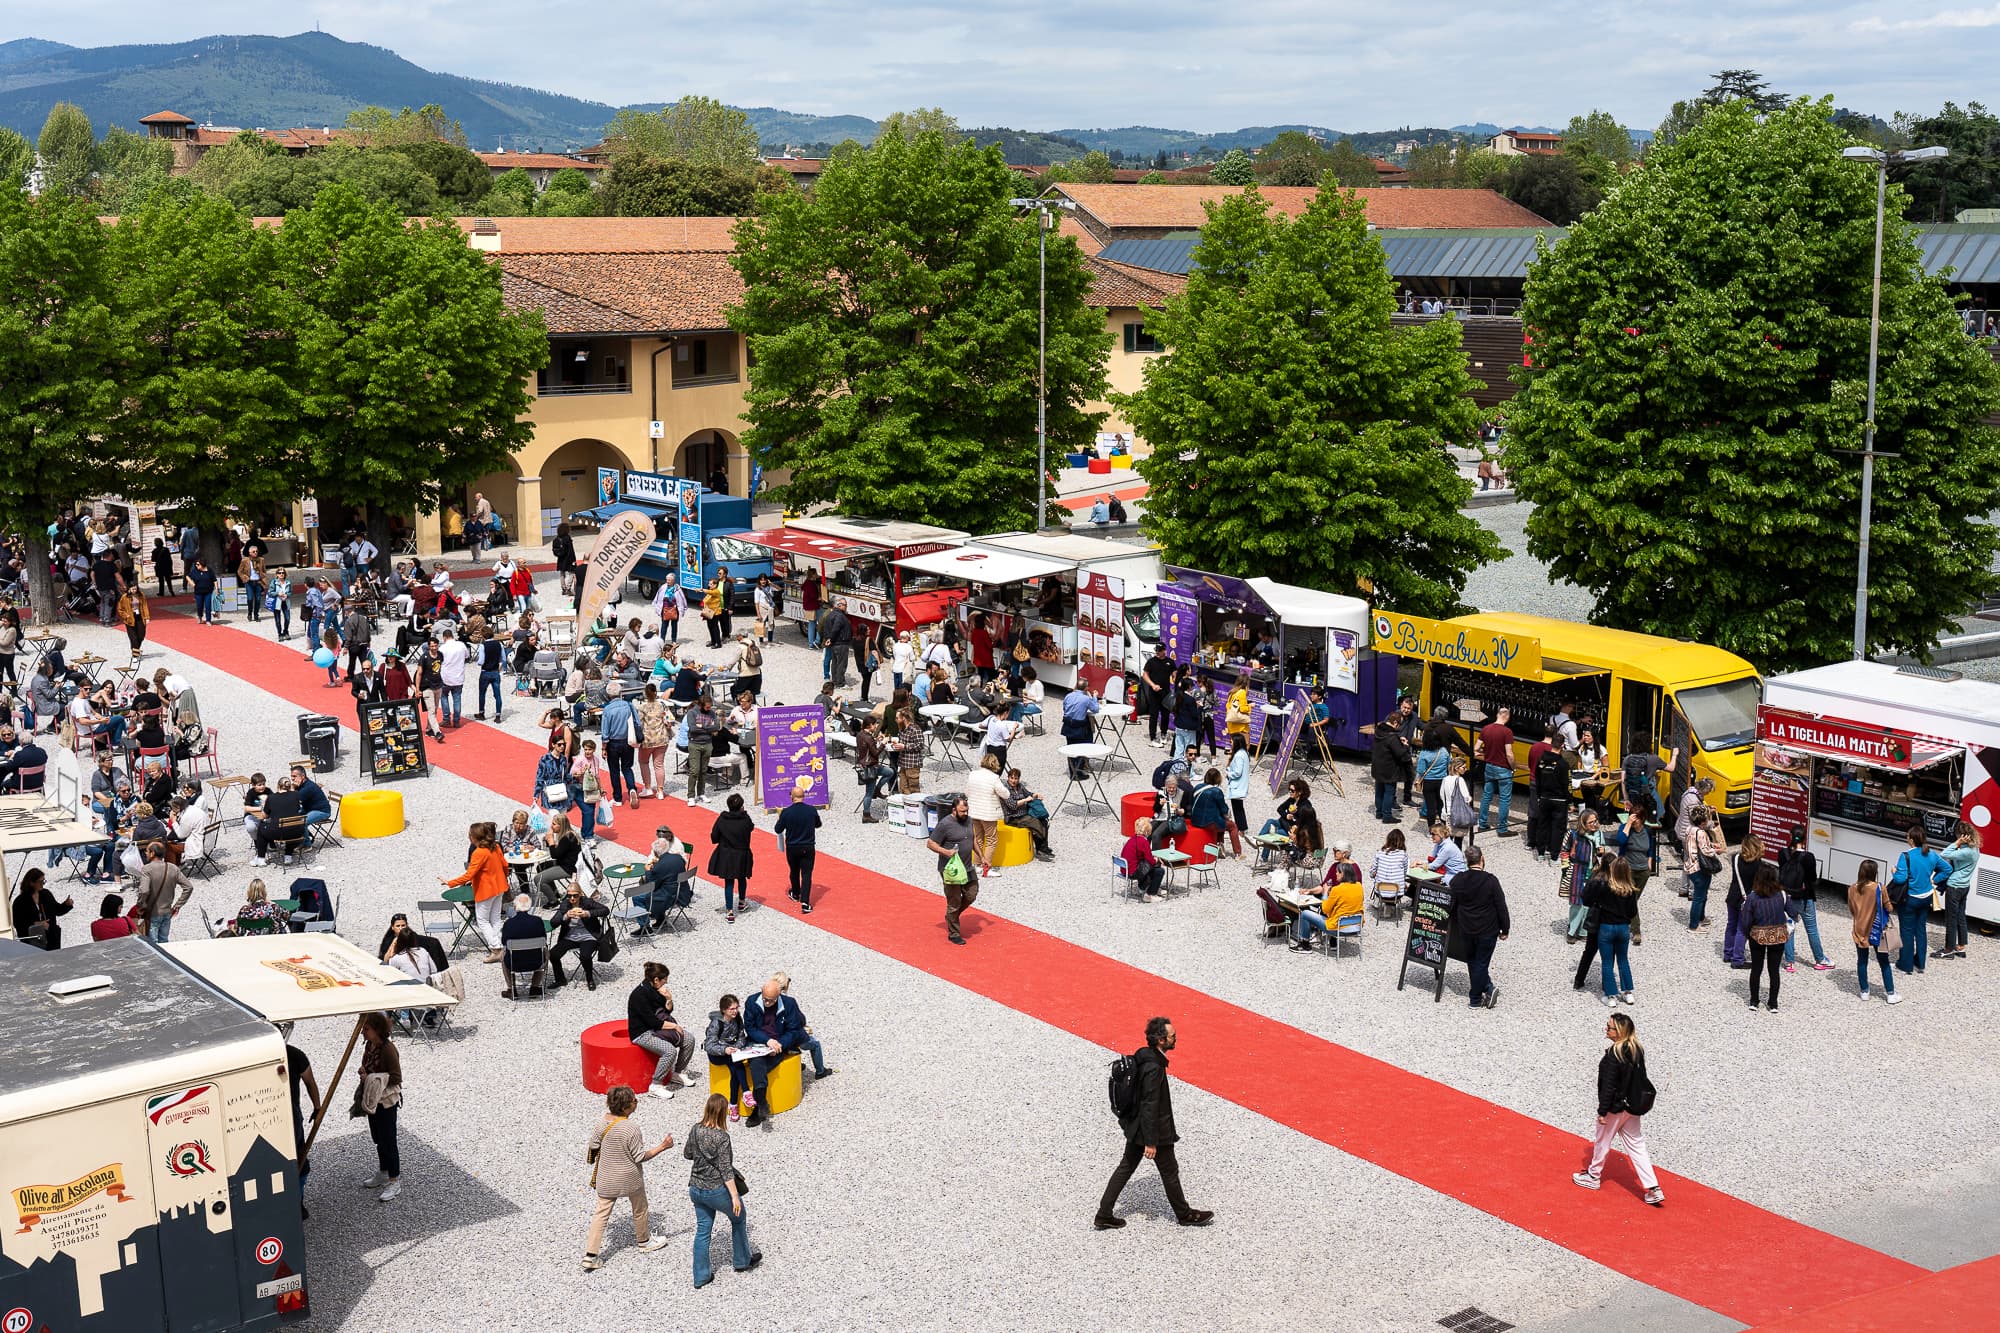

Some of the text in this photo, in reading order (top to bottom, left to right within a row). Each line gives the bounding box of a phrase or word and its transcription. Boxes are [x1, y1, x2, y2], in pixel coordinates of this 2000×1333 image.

[627, 474, 680, 499] GREEK EA
[593, 519, 634, 568] TORTELLO
[597, 530, 647, 591] MUGELLANO
[1394, 621, 1488, 667] Birrabus
[1770, 722, 1889, 757] LA TIGELLAIA MATTA
[20, 1188, 49, 1207] Olive
[67, 1169, 115, 1200] Ascolana
[47, 1200, 74, 1211] artigianale
[73, 1186, 98, 1203] realizzato
[41, 1203, 105, 1225] direttamente da
[41, 1212, 107, 1235] Ascoli Piceno
[51, 1222, 99, 1241] 3478039371
[52, 1231, 100, 1250] 3713615635
[263, 1244, 276, 1257] 80
[276, 1280, 300, 1294] 75109
[10, 1315, 26, 1330] 70
